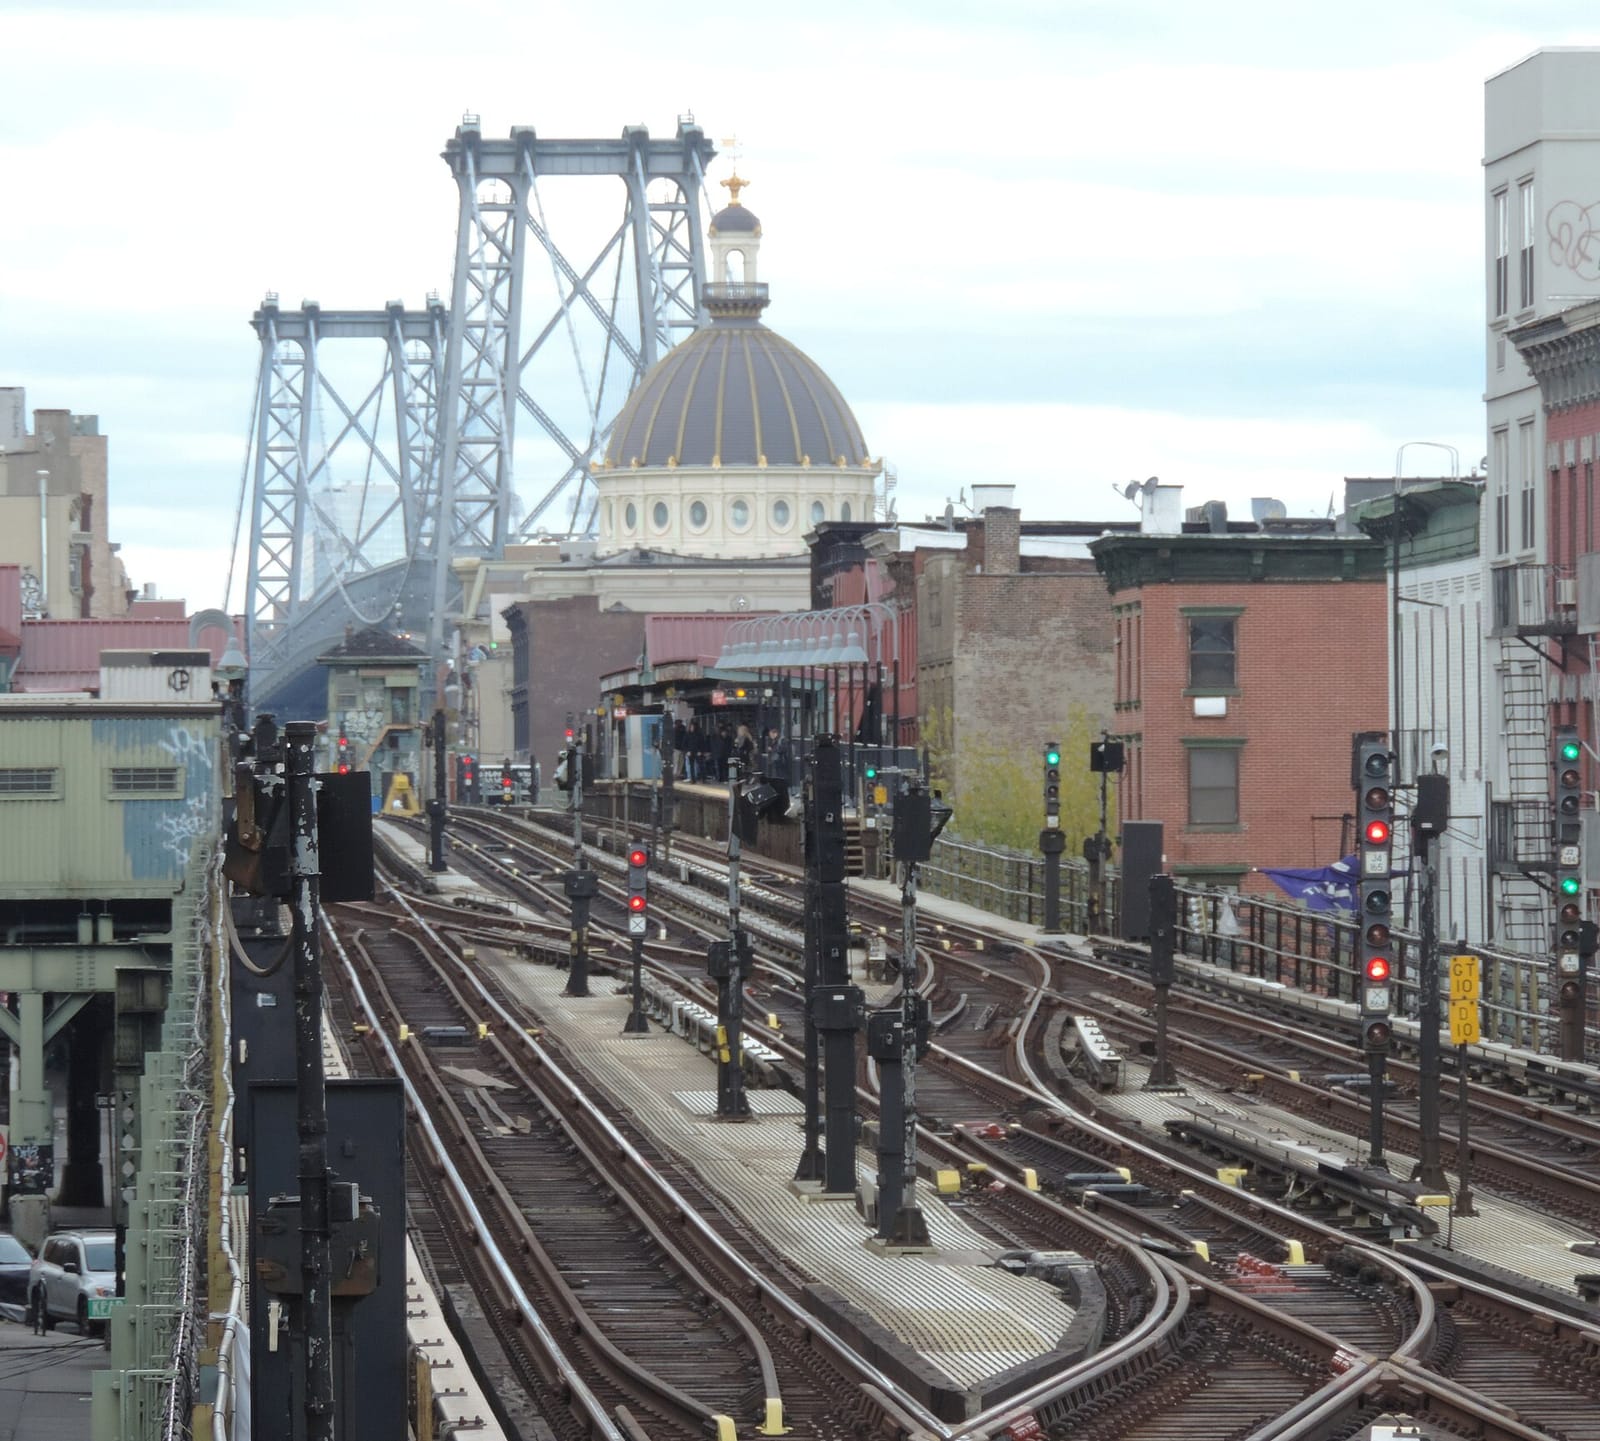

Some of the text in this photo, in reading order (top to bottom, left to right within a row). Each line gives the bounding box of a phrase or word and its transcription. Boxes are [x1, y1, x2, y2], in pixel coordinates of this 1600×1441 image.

[1456, 979, 1473, 993] 10
[1459, 1007, 1469, 1021] D
[1457, 1023, 1473, 1037] 10
